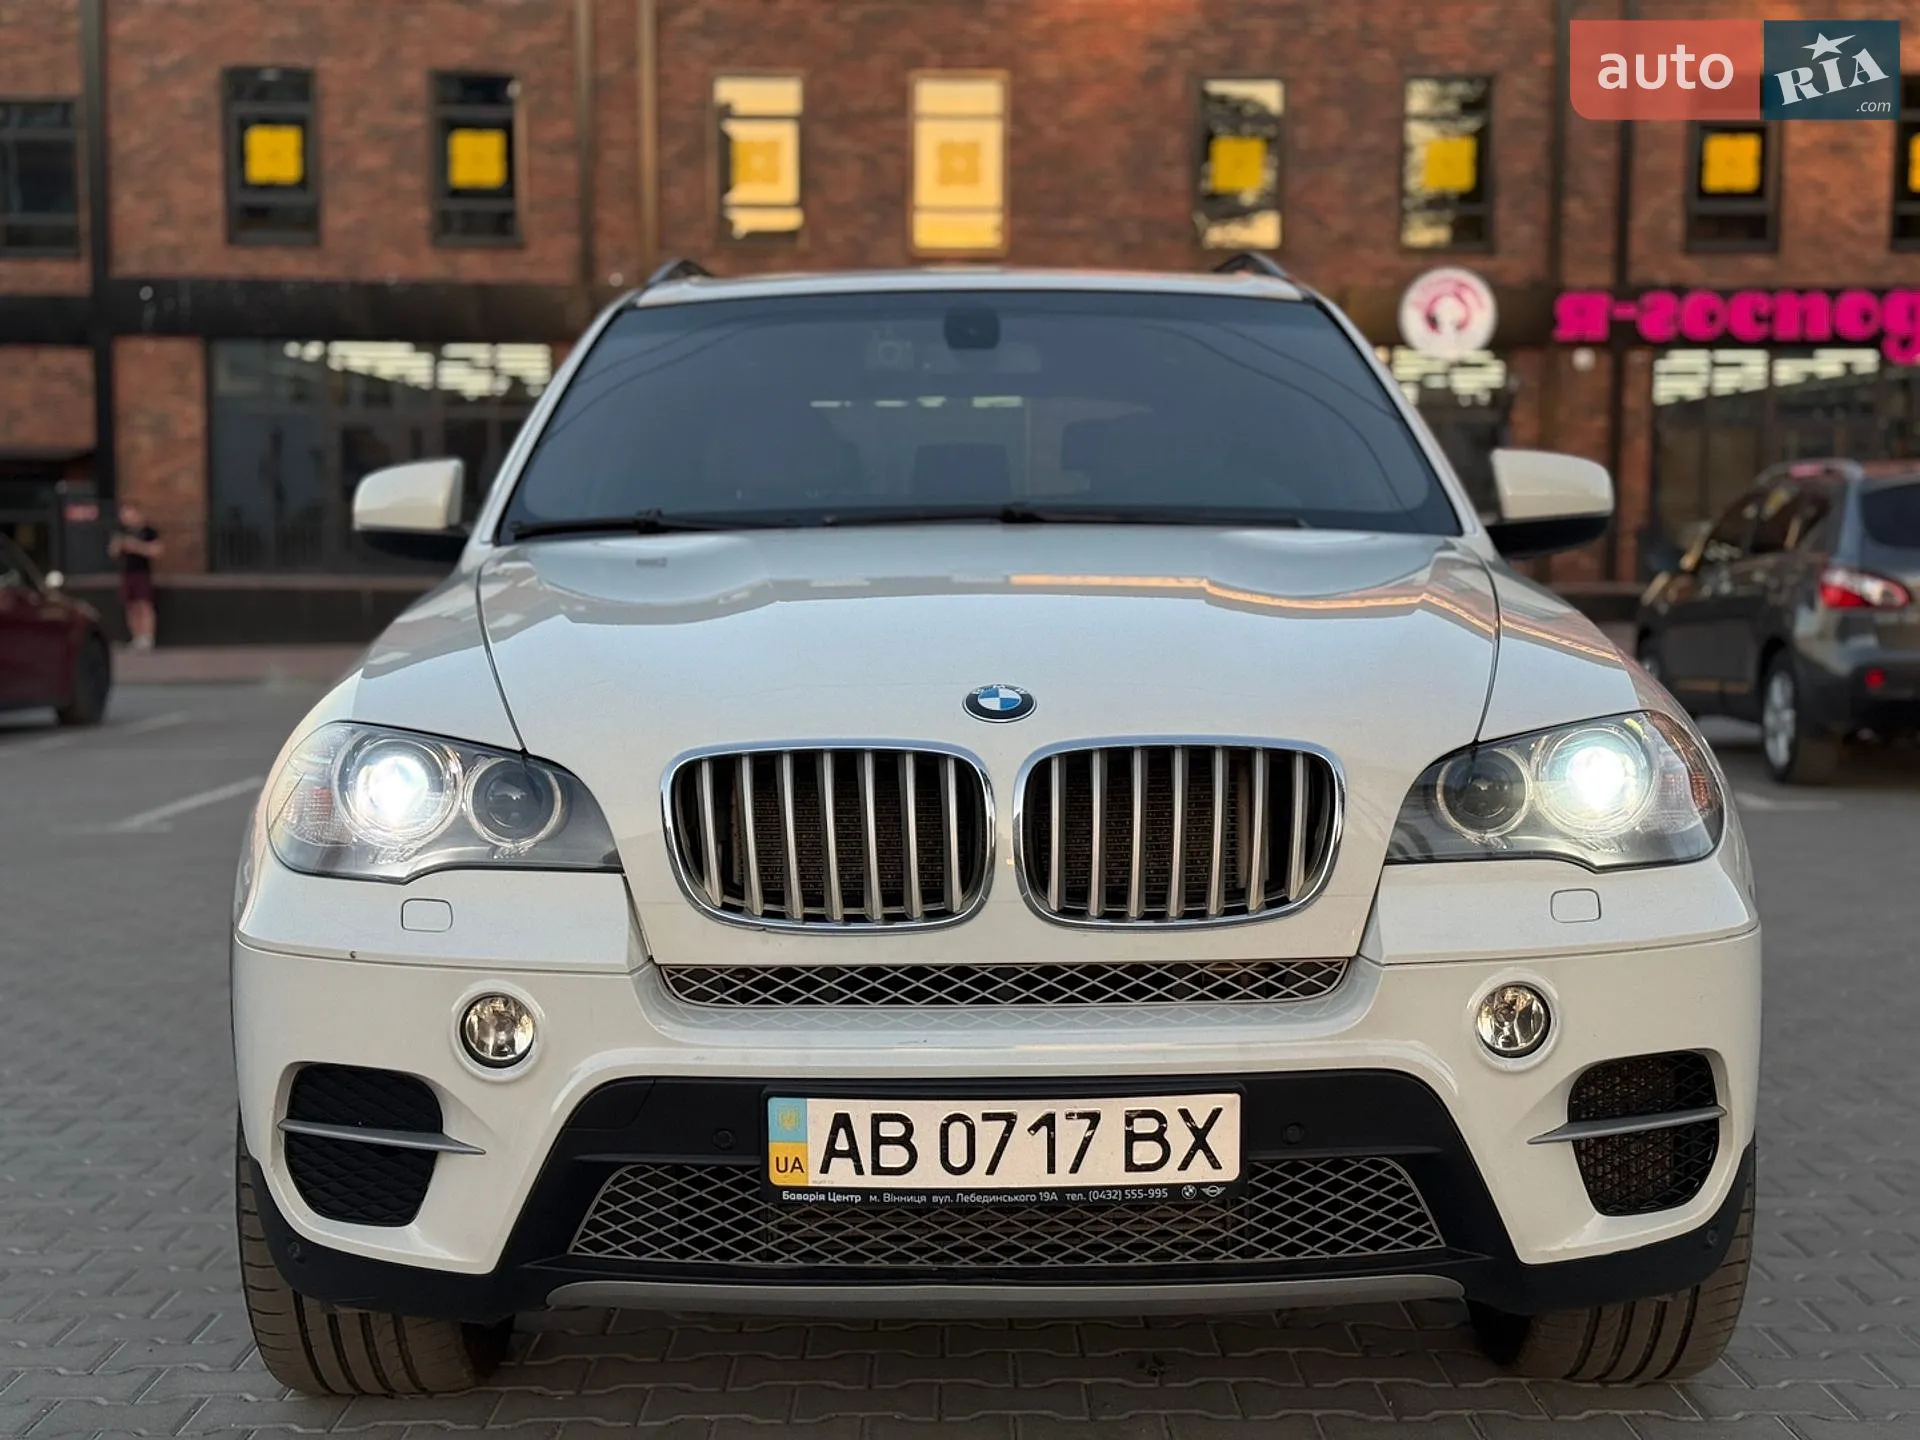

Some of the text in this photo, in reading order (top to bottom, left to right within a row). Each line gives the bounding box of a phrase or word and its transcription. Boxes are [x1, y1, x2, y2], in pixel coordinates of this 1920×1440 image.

[819, 1106, 1224, 1176] AB 0717 BX
[775, 1156, 805, 1174] UA
[828, 1191, 862, 1204] Центр
[869, 1195, 880, 1203] м.
[882, 1192, 927, 1204] Вінниця
[931, 1195, 954, 1205] вул.
[955, 1192, 1037, 1204] Лебединського
[1065, 1192, 1087, 1201] тел.
[1088, 1189, 1122, 1202] (0432)
[1124, 1188, 1169, 1200] 555-995
